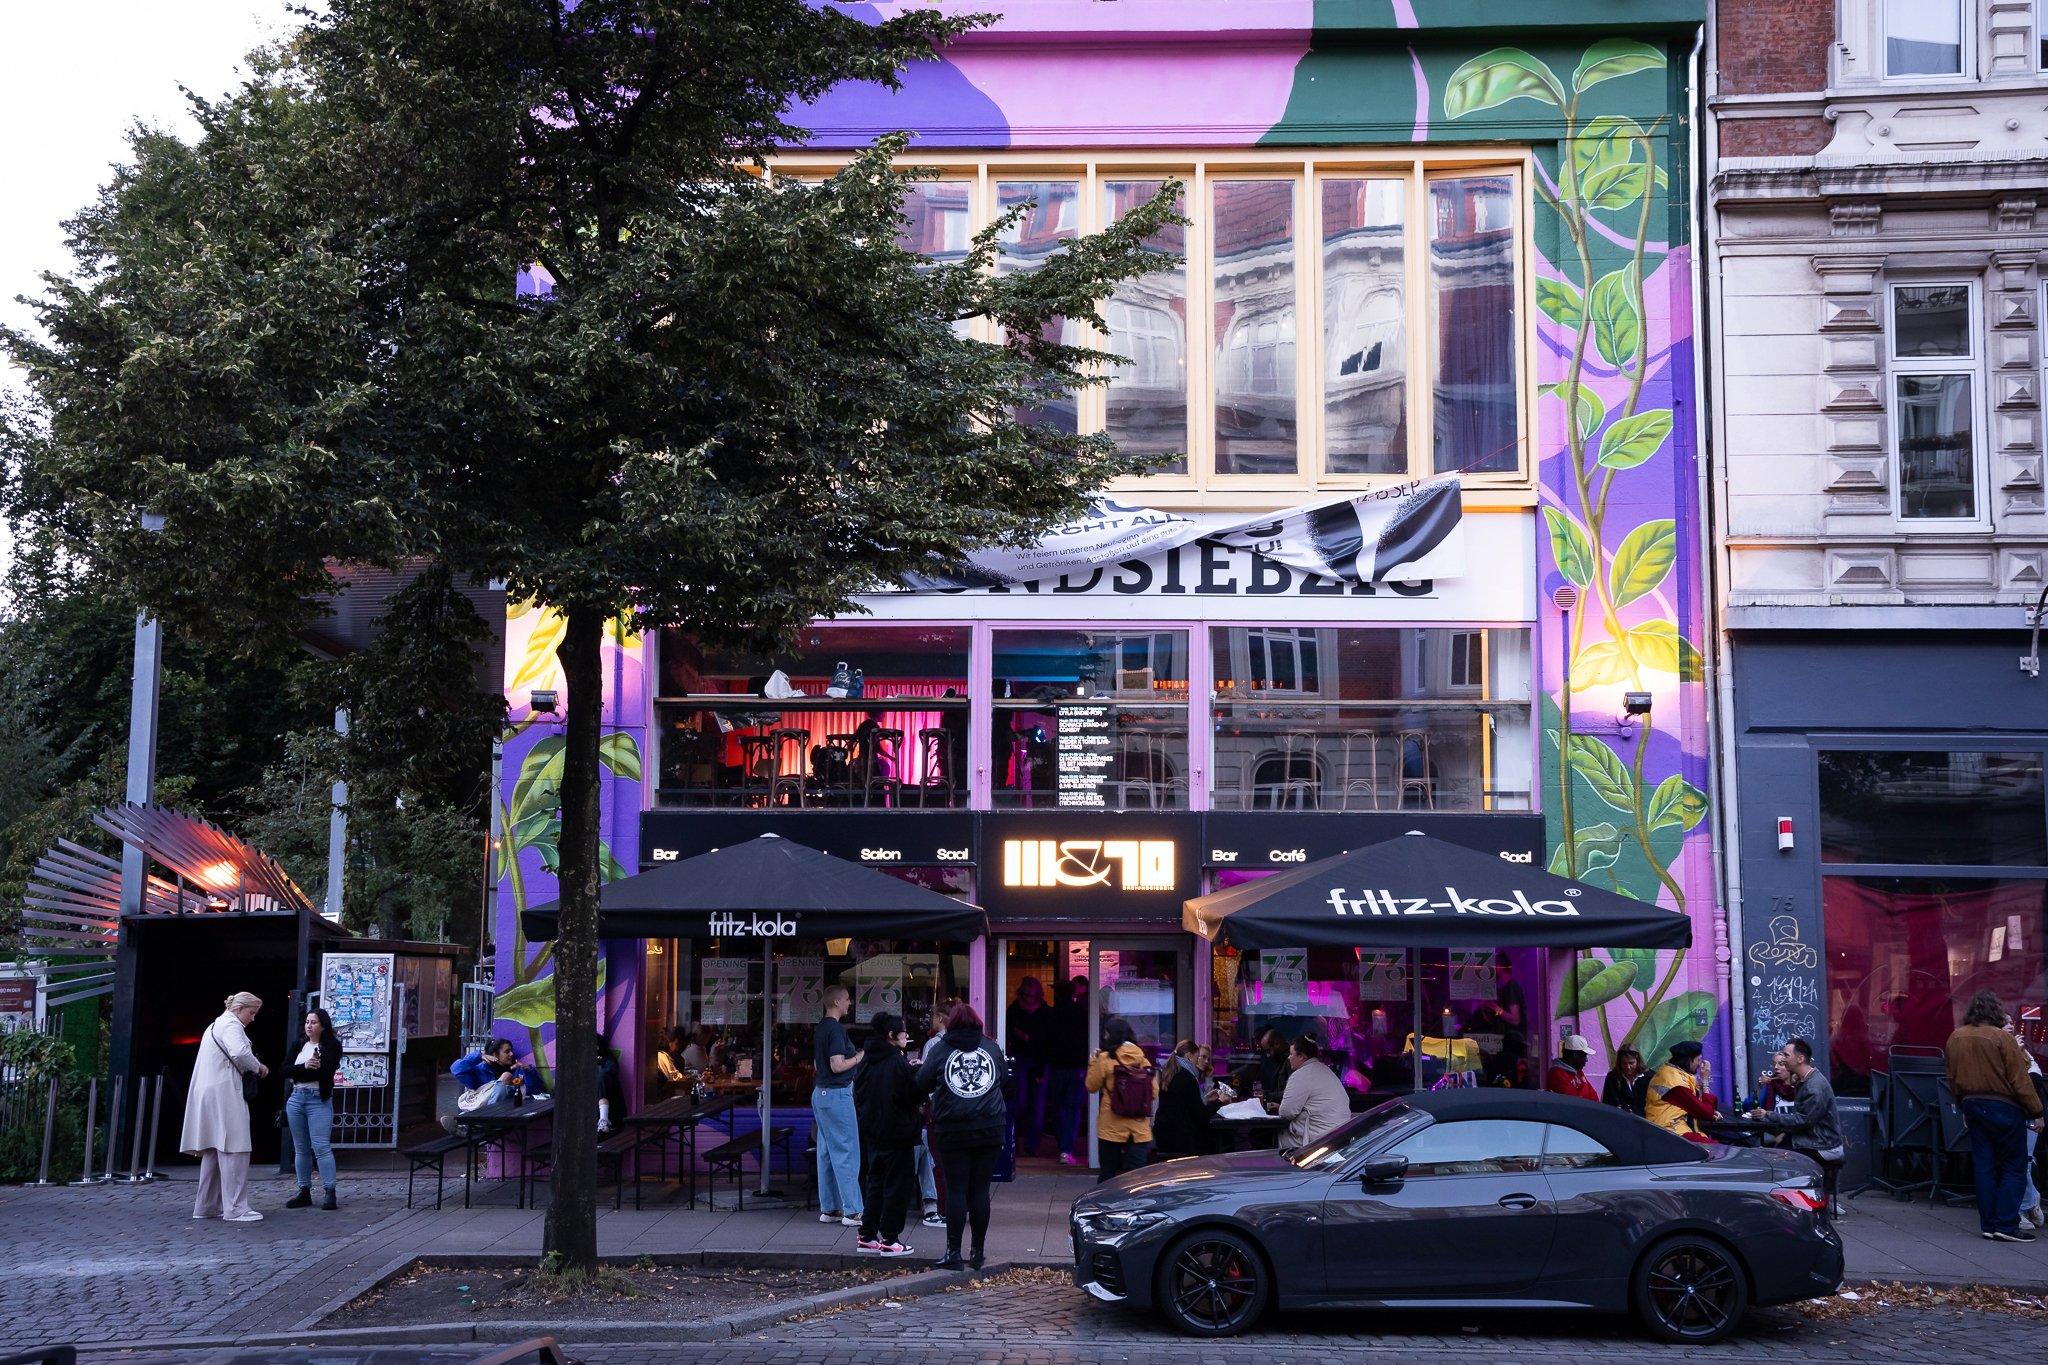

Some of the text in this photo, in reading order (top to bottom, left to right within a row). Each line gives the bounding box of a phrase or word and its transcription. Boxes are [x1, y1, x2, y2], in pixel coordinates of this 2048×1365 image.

[1015, 549, 1032, 560] Wir
[1034, 548, 1058, 559] feiern
[1059, 544, 1095, 556] unseren
[1017, 562, 1034, 571] und
[1126, 538, 1141, 550] auf
[1142, 534, 1160, 546] eine
[653, 848, 679, 860] Bar
[860, 847, 901, 860] Salon
[937, 848, 968, 860] Saal
[1212, 850, 1238, 861] Bar
[1269, 849, 1306, 862] Café
[1500, 851, 1532, 863] Saal
[702, 959, 747, 969] OPENING
[778, 958, 823, 968] OPENING
[1262, 955, 1307, 984] 73
[1360, 953, 1406, 982] 73
[1451, 952, 1496, 981] 73
[703, 977, 747, 1006] 73
[779, 975, 824, 1005] 73
[857, 976, 902, 1006] 73
